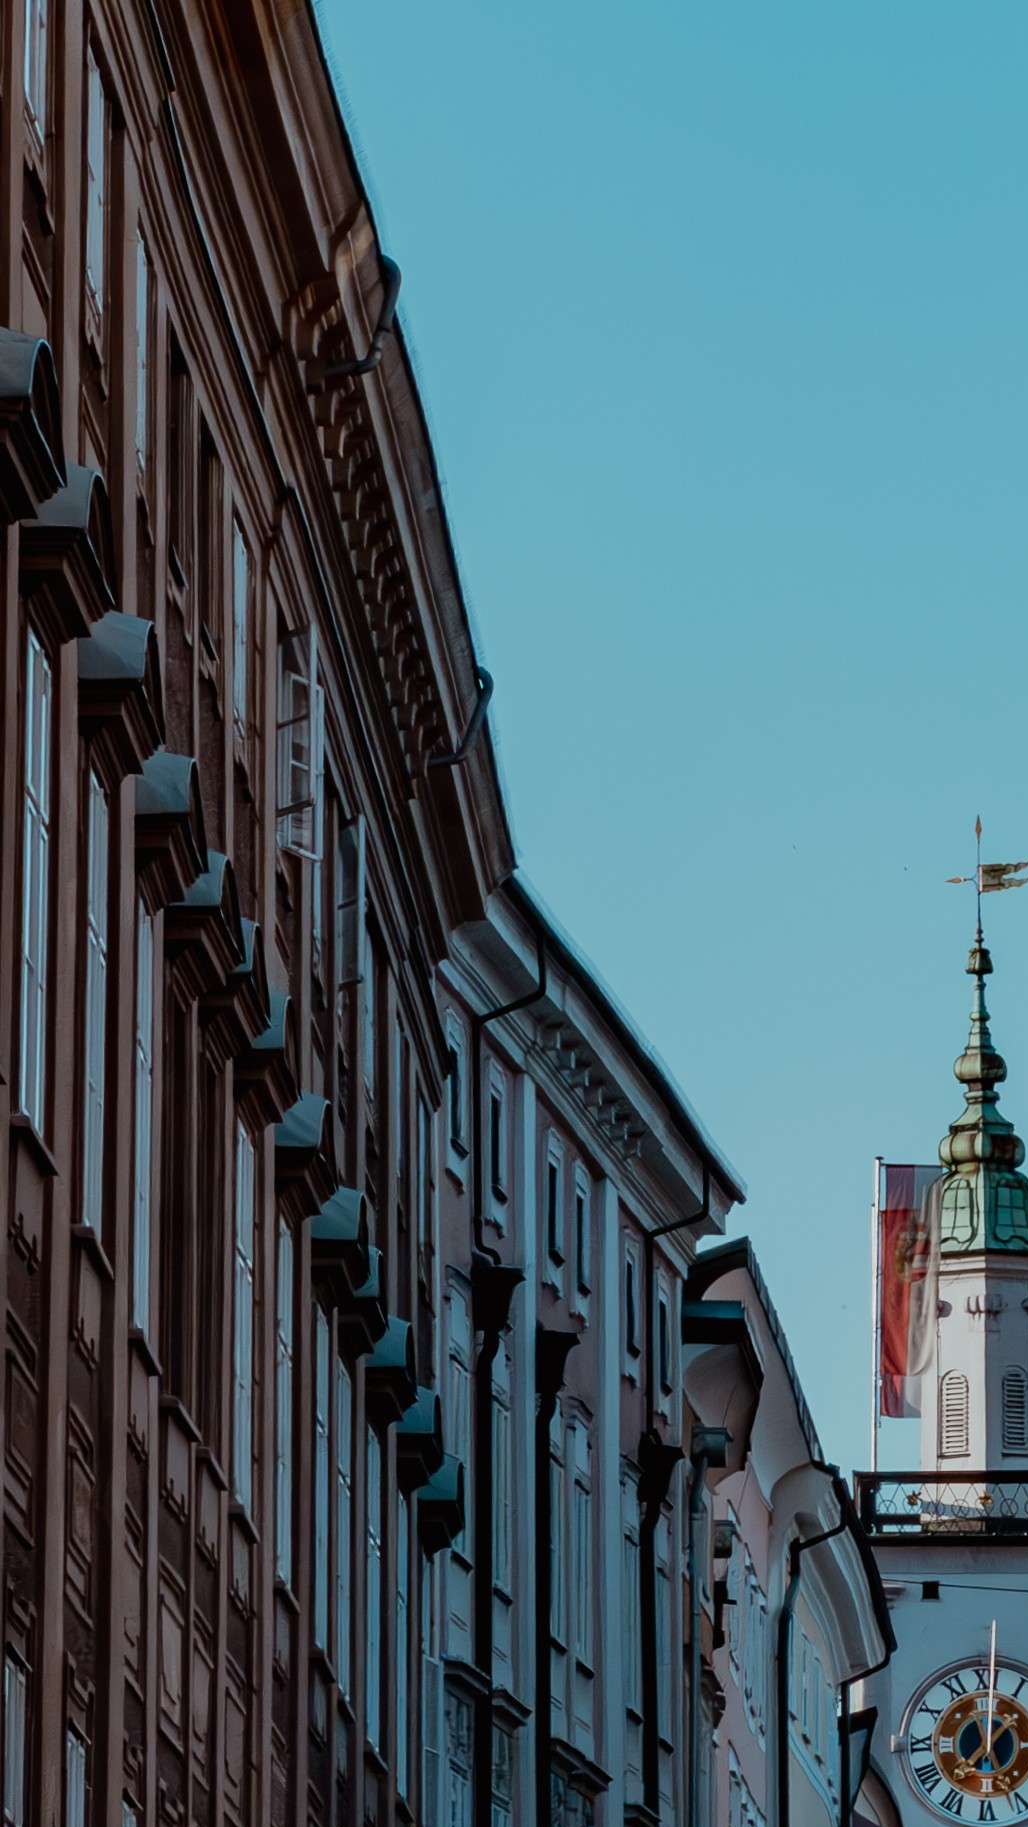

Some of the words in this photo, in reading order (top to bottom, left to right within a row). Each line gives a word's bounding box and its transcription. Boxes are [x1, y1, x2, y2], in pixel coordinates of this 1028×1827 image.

[940, 1674, 967, 1700] XI
[971, 1668, 1000, 1691] XI
[1012, 1677, 1028, 1698] I
[918, 1701, 941, 1723] X
[911, 1734, 932, 1754] IX
[914, 1763, 943, 1795] VIII
[939, 1788, 964, 1816] VII
[978, 1799, 998, 1822] VI
